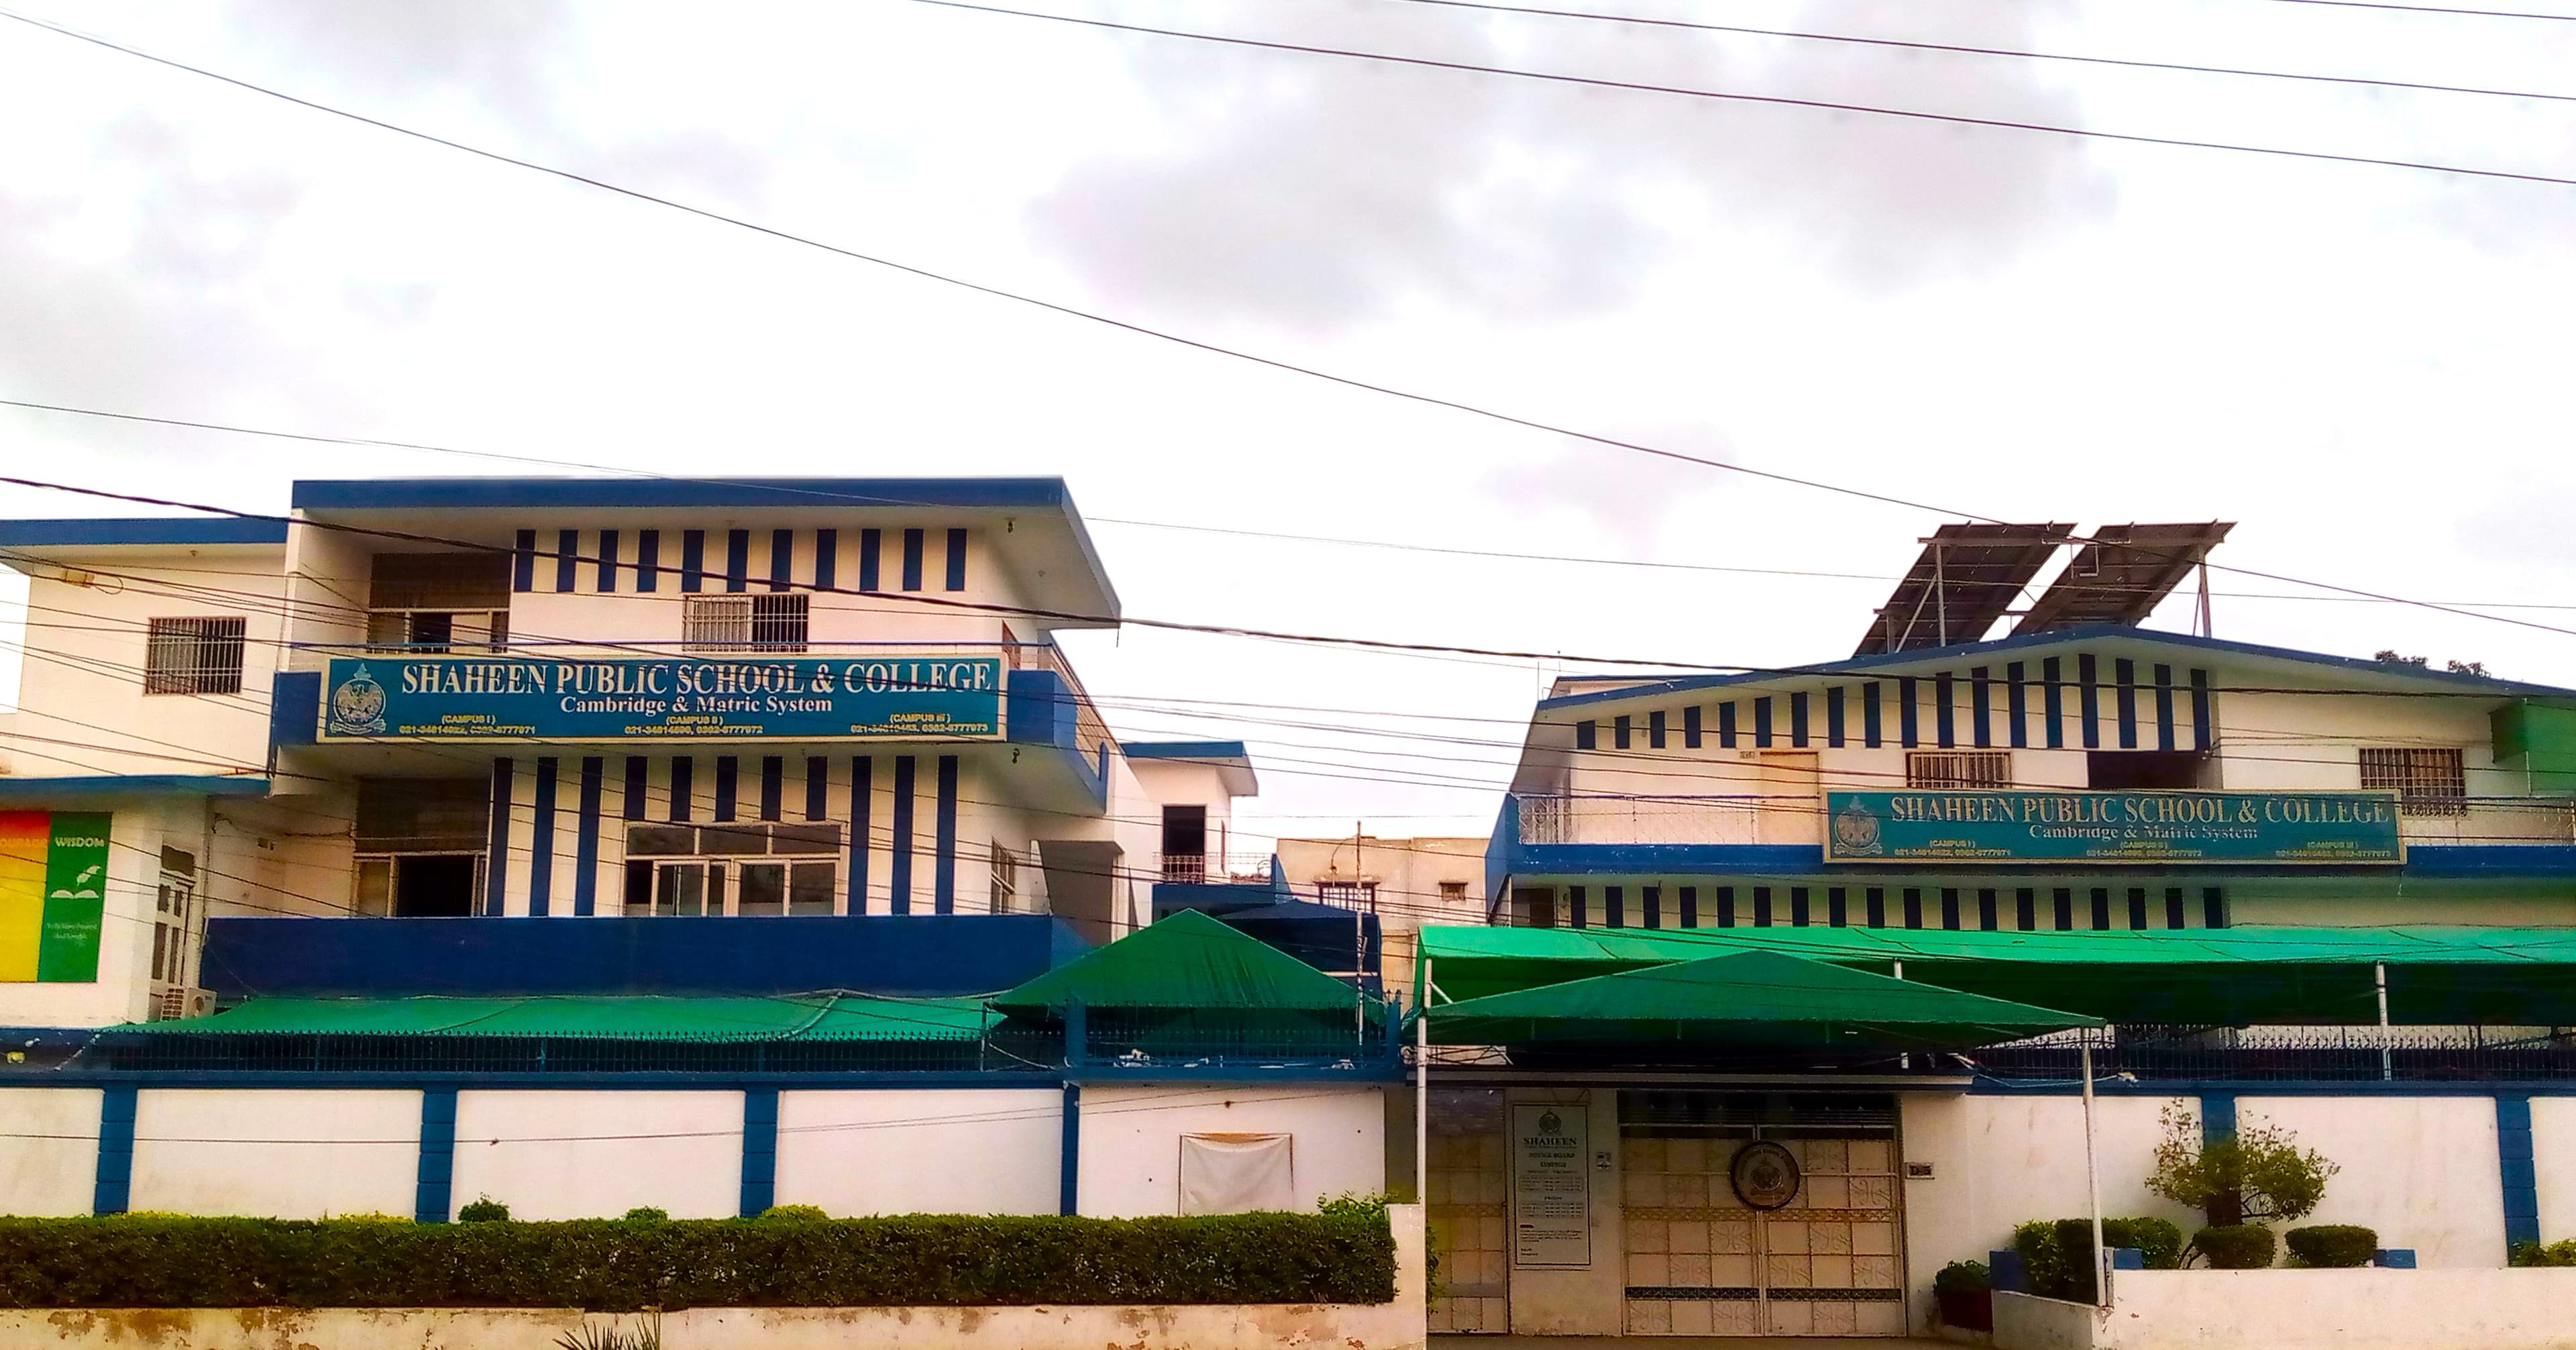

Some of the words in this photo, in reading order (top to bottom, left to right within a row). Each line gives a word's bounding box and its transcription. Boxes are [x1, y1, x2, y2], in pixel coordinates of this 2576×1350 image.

[403, 665, 547, 693] SHAHEEN
[557, 664, 668, 693] PUBLIC
[677, 664, 804, 693] SCHOOL
[812, 664, 834, 692] &
[845, 664, 990, 692] COLLEGE
[561, 696, 665, 716] Cambridge
[672, 696, 688, 712] &
[697, 696, 759, 711] Matric
[767, 696, 831, 715] System
[442, 715, 484, 724] (CAMPUS
[667, 717, 709, 725] (CAMPUS
[890, 714, 934, 723] (CAMPUS
[1891, 797, 2015, 822] SHAHEEN
[2023, 798, 2116, 822] PUBLIC
[2125, 798, 2232, 823] SCHOOL
[2239, 800, 2256, 822] &
[2265, 798, 2388, 823] COLLEGE
[2030, 825, 2118, 840] Cambridge
[2125, 825, 2137, 837] &
[2202, 826, 2257, 841] System
[55, 837, 105, 847] WISDOM
[1523, 1137, 1577, 1145] SHAHEEN
